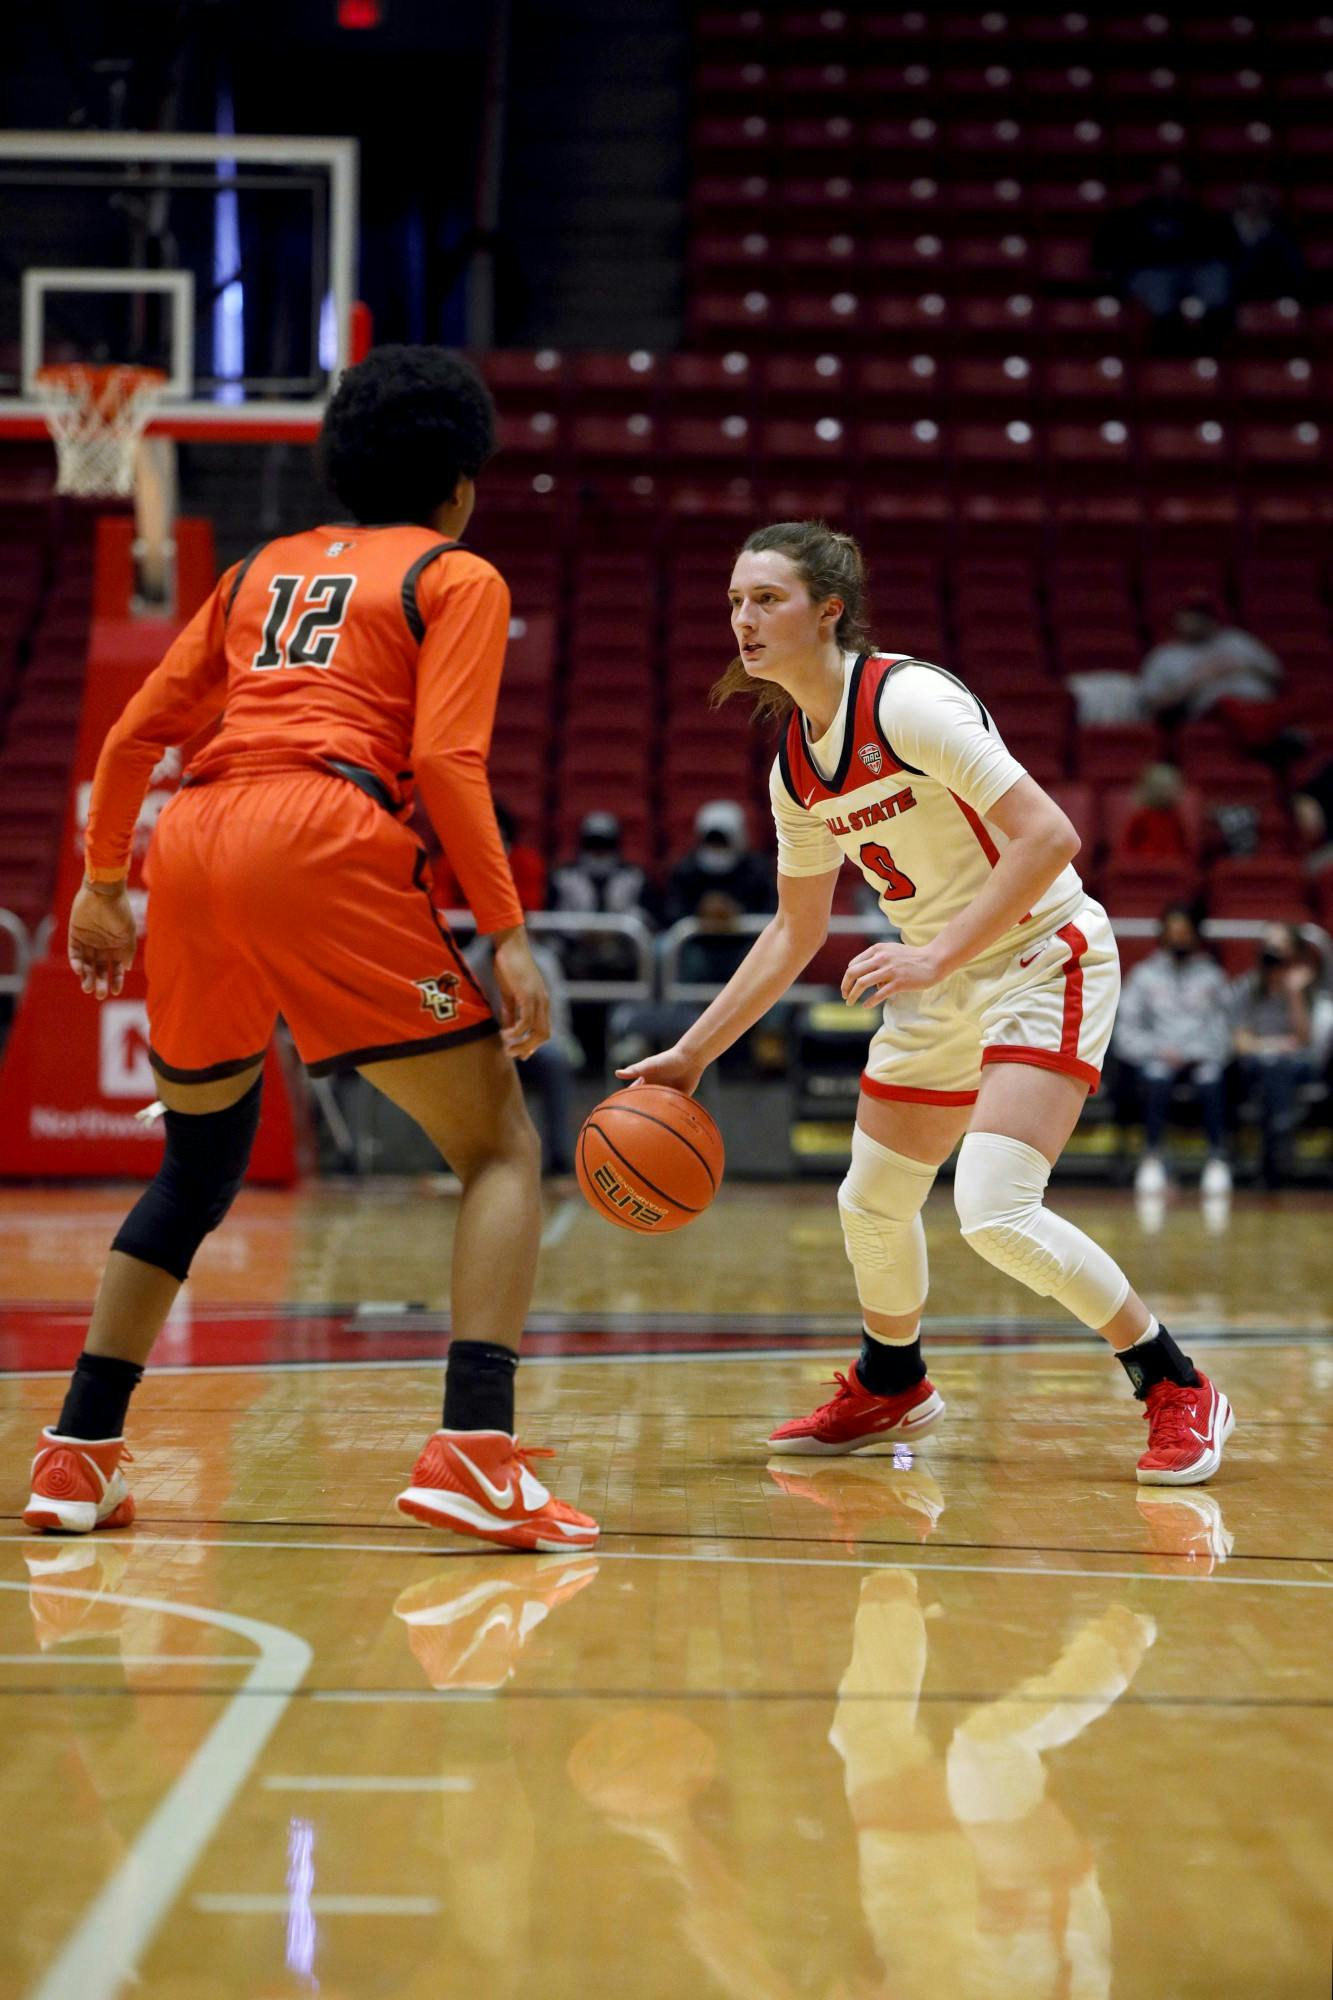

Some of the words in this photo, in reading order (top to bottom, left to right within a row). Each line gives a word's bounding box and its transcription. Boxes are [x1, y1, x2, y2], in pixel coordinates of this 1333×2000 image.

[251, 573, 358, 671] 12
[847, 786, 917, 832] STATE
[592, 1164, 664, 1227] ELITE
